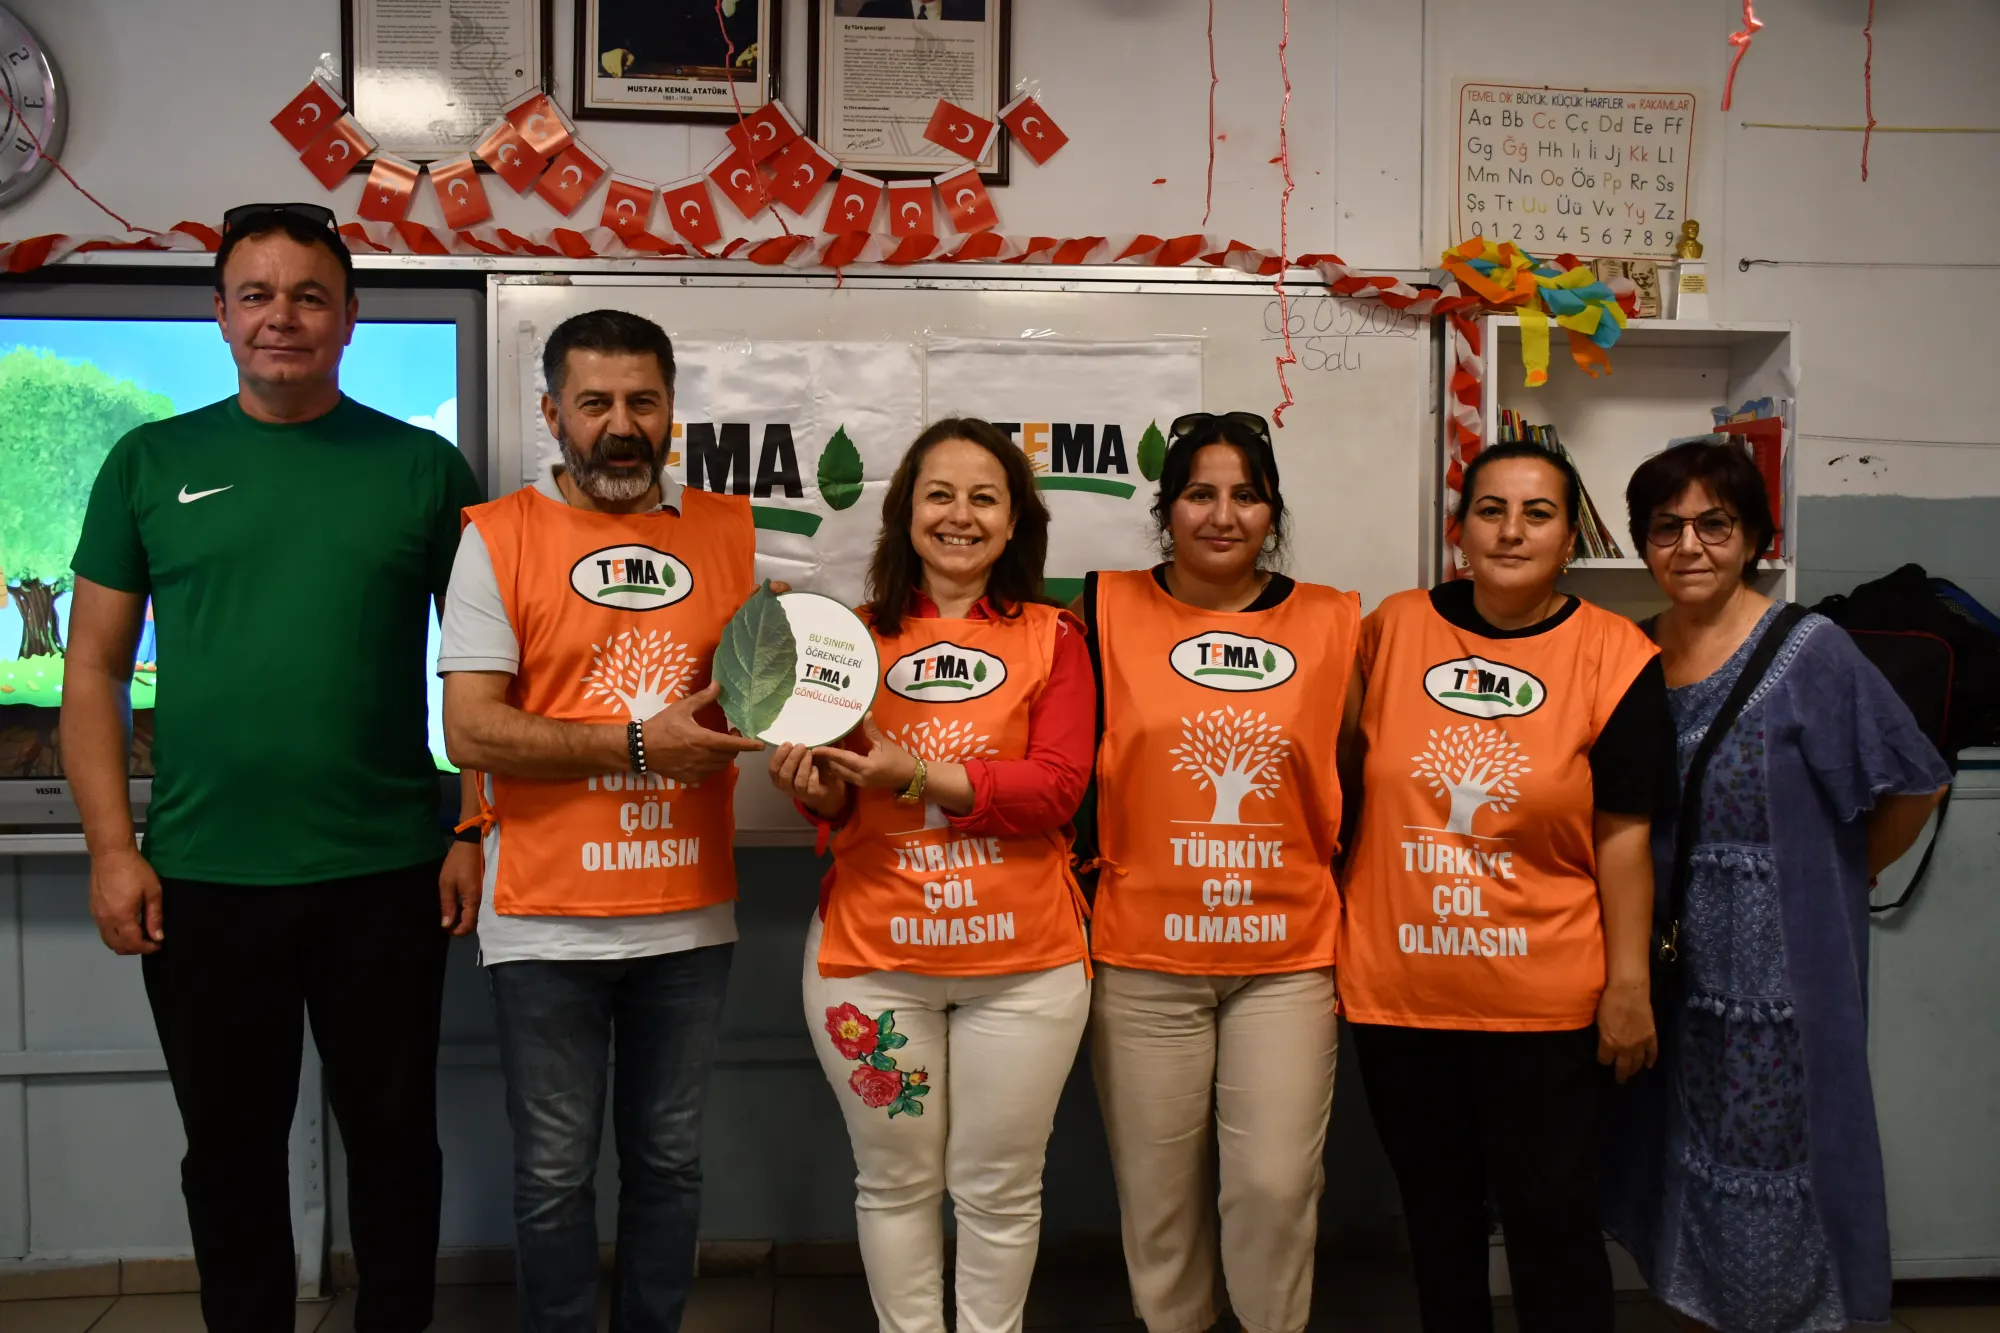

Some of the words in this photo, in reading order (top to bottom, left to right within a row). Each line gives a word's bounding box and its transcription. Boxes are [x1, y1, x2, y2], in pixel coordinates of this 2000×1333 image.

[627, 85, 663, 94] MUSTAFA
[665, 86, 691, 95] KEMAL
[692, 86, 727, 95] ATATÜRK
[1467, 91, 1496, 103] TEMEL
[1552, 93, 1583, 108] KÜÇÜK
[1585, 97, 1624, 109] HARFLER
[1639, 99, 1690, 111] RAKAMLAR
[1468, 108, 1492, 126] Aa
[1502, 110, 1523, 128] Bb
[1532, 112, 1556, 130] Cc
[1566, 113, 1589, 133] Çç
[1600, 115, 1623, 133] Dd
[1633, 116, 1653, 134] Ee
[1664, 117, 1683, 134] Ff
[1467, 137, 1493, 161] Gg
[1502, 135, 1528, 163] Ğğ
[1538, 140, 1563, 158] Hh
[1605, 144, 1621, 167] Jj
[1629, 145, 1648, 163] Kk
[1467, 166, 1499, 183] Mm
[1508, 168, 1532, 185] Nn
[1541, 169, 1564, 186] Oo
[1571, 167, 1595, 188] Öö
[1603, 172, 1622, 195] Pp
[1631, 174, 1648, 190] Rr
[1656, 175, 1674, 192] Ss
[1467, 194, 1485, 213] Şş
[1495, 194, 1513, 212] Tt
[1522, 196, 1547, 214] Uu
[1557, 194, 1582, 216] Üü
[1592, 200, 1614, 217] Vv
[1625, 202, 1645, 225] Yy
[1654, 203, 1675, 220] Zz
[1471, 221, 1483, 237] 0
[1491, 222, 1499, 238] 1
[1512, 223, 1522, 240] 2
[1534, 225, 1545, 241] 3
[1556, 226, 1568, 242] 4
[1580, 227, 1590, 243] 5
[1602, 228, 1612, 244] 6
[1623, 229, 1632, 245] 7
[1643, 230, 1653, 246] 8
[1665, 231, 1674, 247] 9
[596, 558, 660, 585] TEMA
[805, 645, 863, 669] ÖĞRENCİLERİ
[808, 633, 822, 643] BU
[823, 636, 855, 651] SINIFIN
[1197, 643, 1259, 668] TEMA
[805, 663, 840, 685] TEMA
[913, 655, 970, 681] TEMA
[1453, 668, 1511, 698] TEMA
[794, 687, 863, 711] GÖNÜLLÜSÜDÜR
[36, 787, 62, 795] VESTEL
[620, 795, 674, 836] ÇÖL
[582, 837, 700, 872] OLMASIN
[893, 833, 1004, 873] TÜRKİYE
[1169, 832, 1284, 869] TÜRKİYE
[1401, 835, 1516, 879] TÜRKİYE
[923, 873, 978, 914] ÇÖL
[1202, 872, 1254, 912] ÇÖL
[1432, 878, 1489, 924] ÇÖL
[890, 912, 1015, 946] OLMASIN
[1164, 913, 1287, 943] OLMASIN
[1398, 923, 1528, 957] OLMASIN
